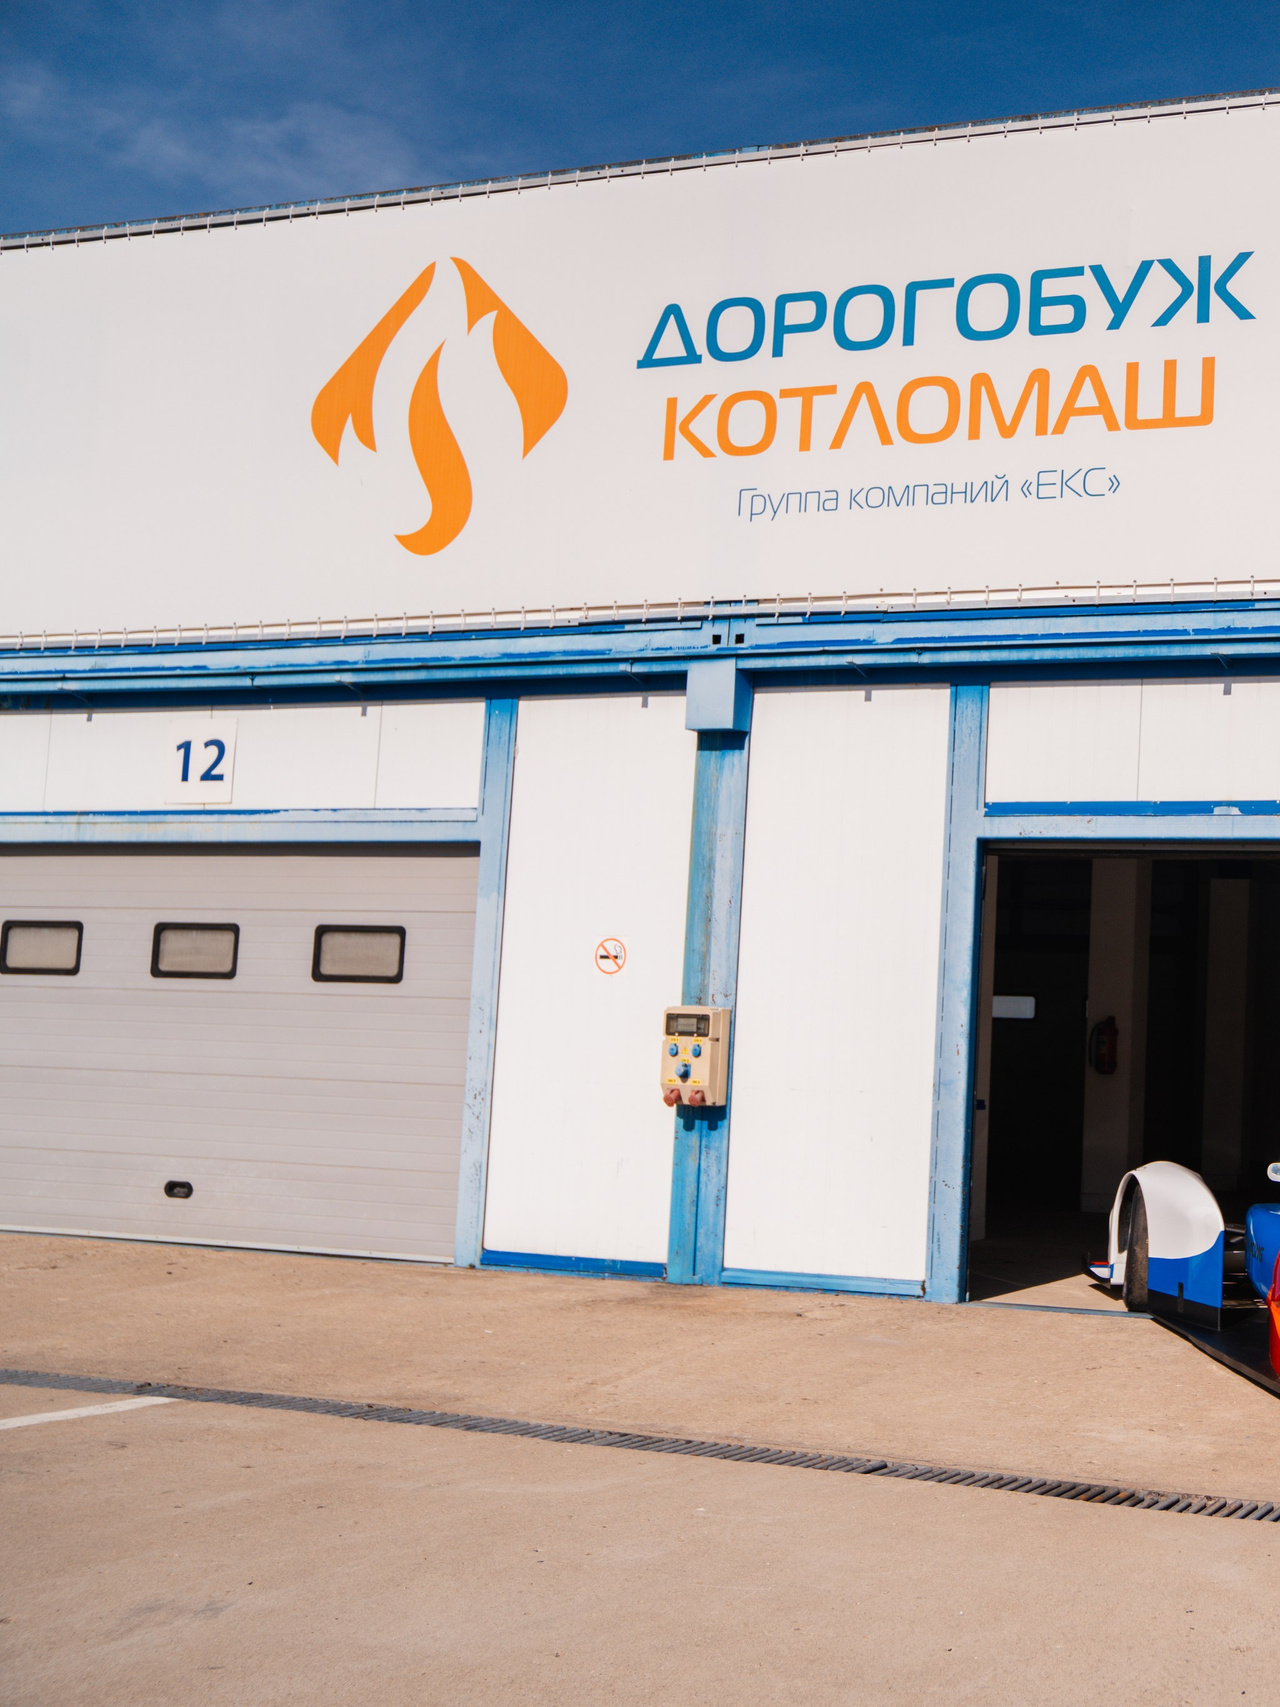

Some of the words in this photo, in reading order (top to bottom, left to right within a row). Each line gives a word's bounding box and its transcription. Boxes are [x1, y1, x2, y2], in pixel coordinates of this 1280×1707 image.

[637, 251, 1256, 370] ДОРОГОБУЖ
[662, 356, 1216, 462] КОТЛОМАШ
[737, 487, 840, 523] Группа
[849, 474, 1010, 511] компаний
[1020, 467, 1122, 502] «ЕКС»
[175, 738, 227, 783] 12
